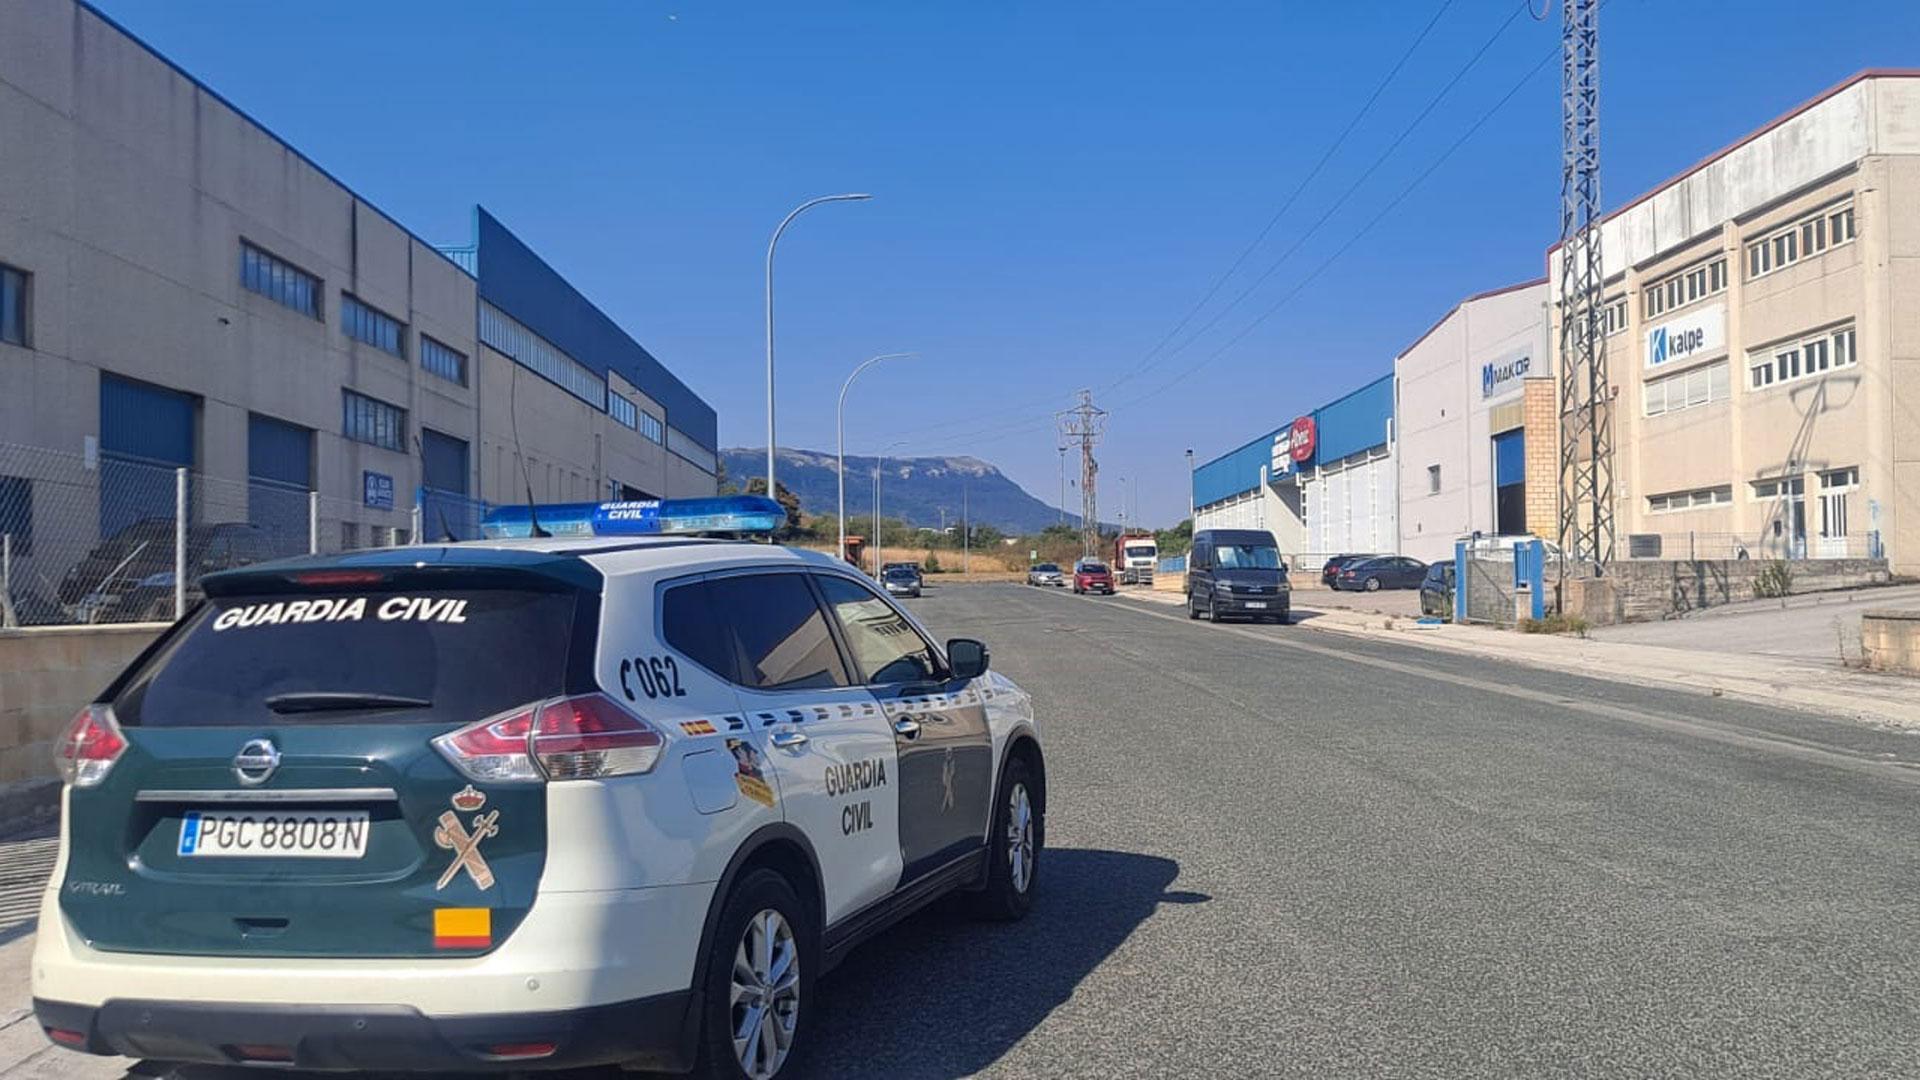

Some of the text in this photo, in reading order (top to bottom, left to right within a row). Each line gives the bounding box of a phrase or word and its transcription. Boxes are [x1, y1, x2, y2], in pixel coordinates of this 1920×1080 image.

[1669, 327, 1704, 356] kalpe
[1494, 357, 1530, 383] MAKOR
[601, 501, 659, 510] GUARDIA
[608, 510, 642, 519] CIVIL
[213, 595, 468, 631] GUARDIA CIVIL
[634, 655, 687, 699] 062
[825, 758, 887, 797] GUARDIA
[841, 801, 873, 836] CIVIL
